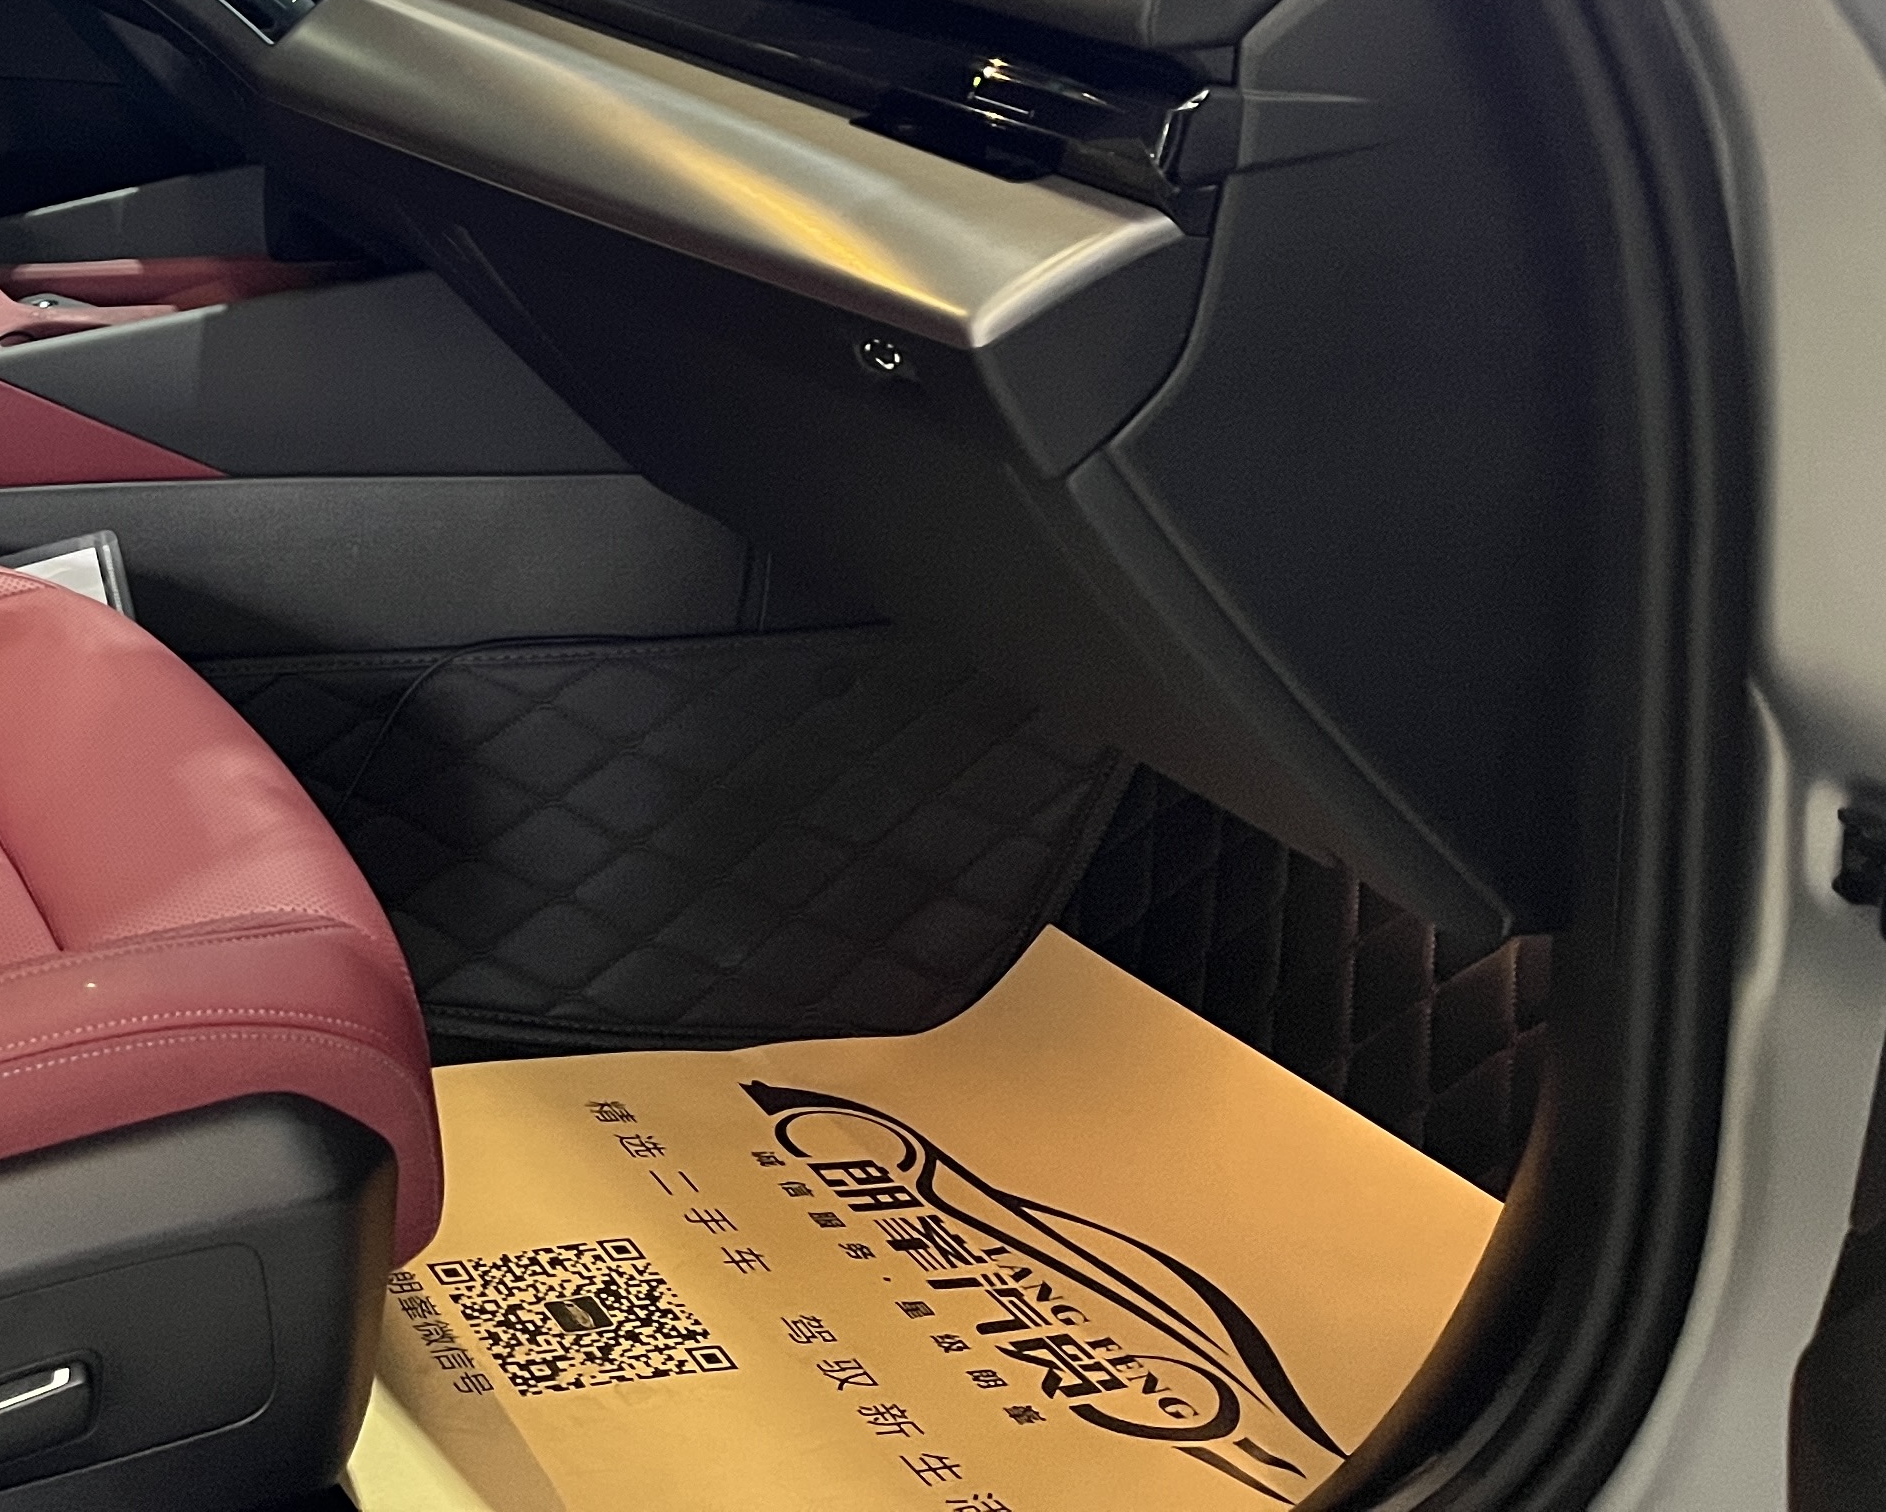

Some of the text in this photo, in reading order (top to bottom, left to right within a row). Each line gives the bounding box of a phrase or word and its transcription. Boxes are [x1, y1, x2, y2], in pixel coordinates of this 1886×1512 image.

[584, 1099, 772, 1275] 精选二手车
[387, 1270, 495, 1396] 朗峯微信号
[806, 1158, 1130, 1400] 朗峯汽贸
[979, 1244, 1201, 1421] LANG FENG
